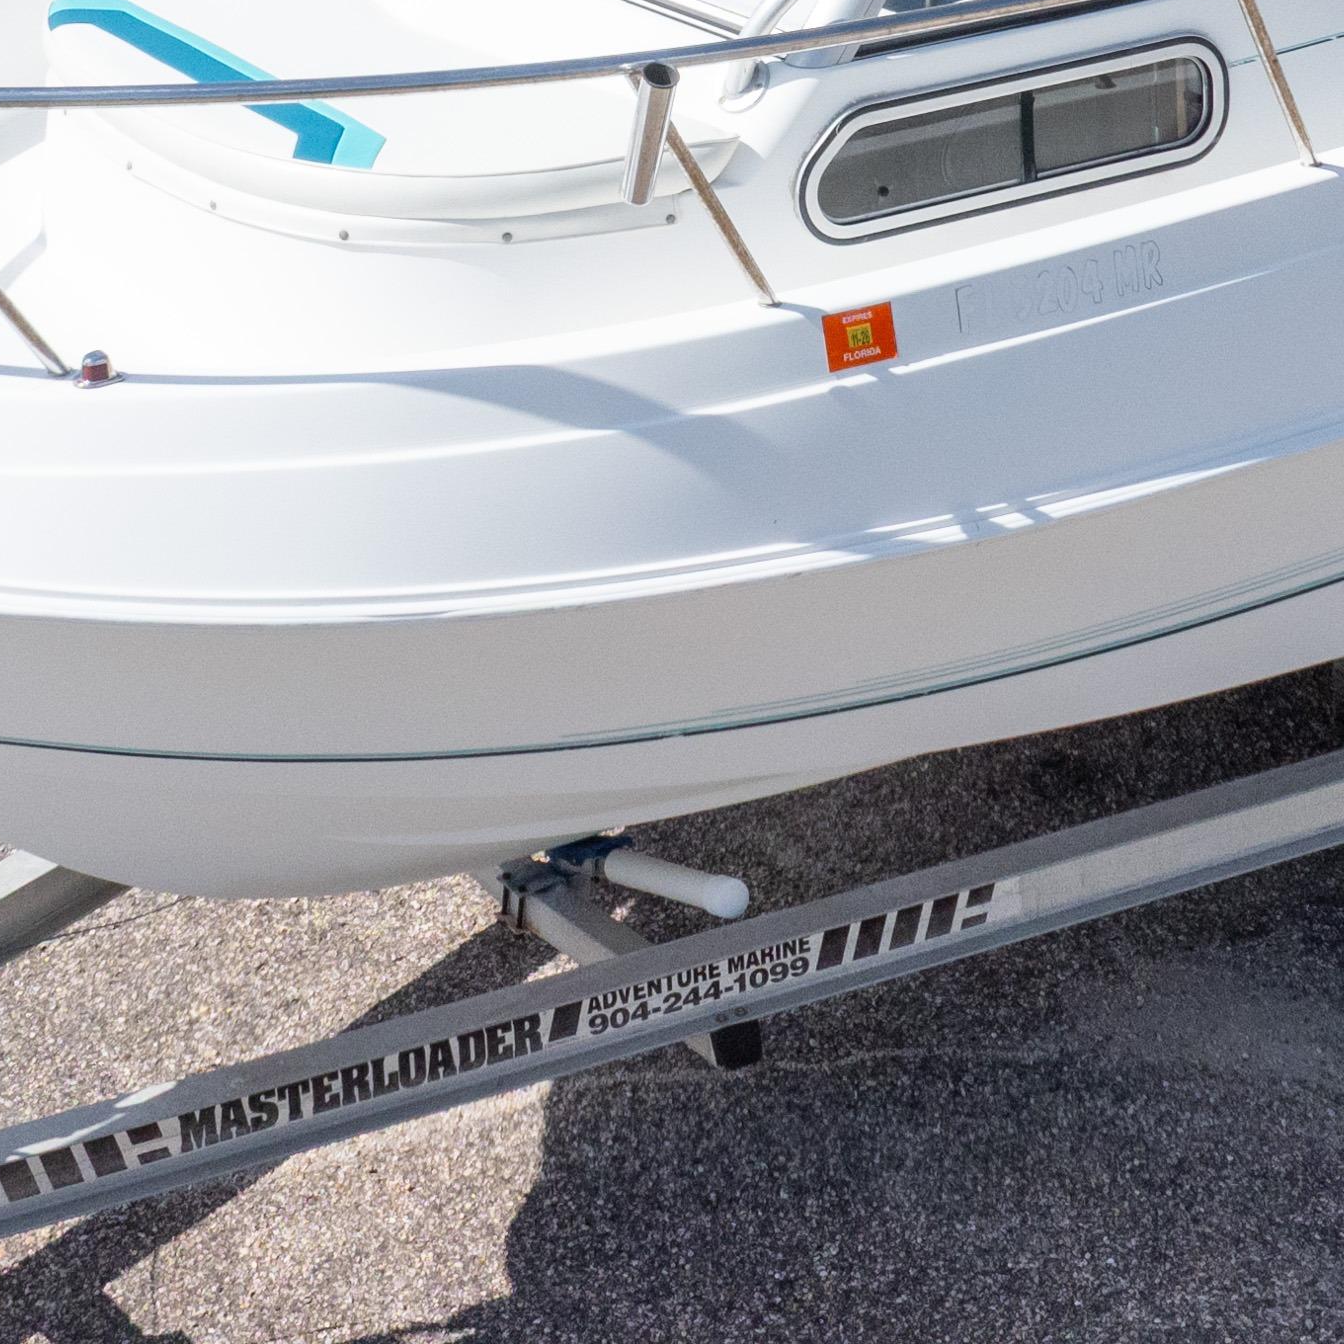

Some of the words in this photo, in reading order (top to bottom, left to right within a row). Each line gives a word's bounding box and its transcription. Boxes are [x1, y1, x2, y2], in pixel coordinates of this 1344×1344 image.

[843, 346, 881, 362] FLORIDA
[587, 963, 721, 1015] ADVENTURE
[728, 936, 812, 973] MARINE
[588, 957, 810, 1036] 904-244-1099
[178, 1013, 544, 1153] MASTERLOADER
